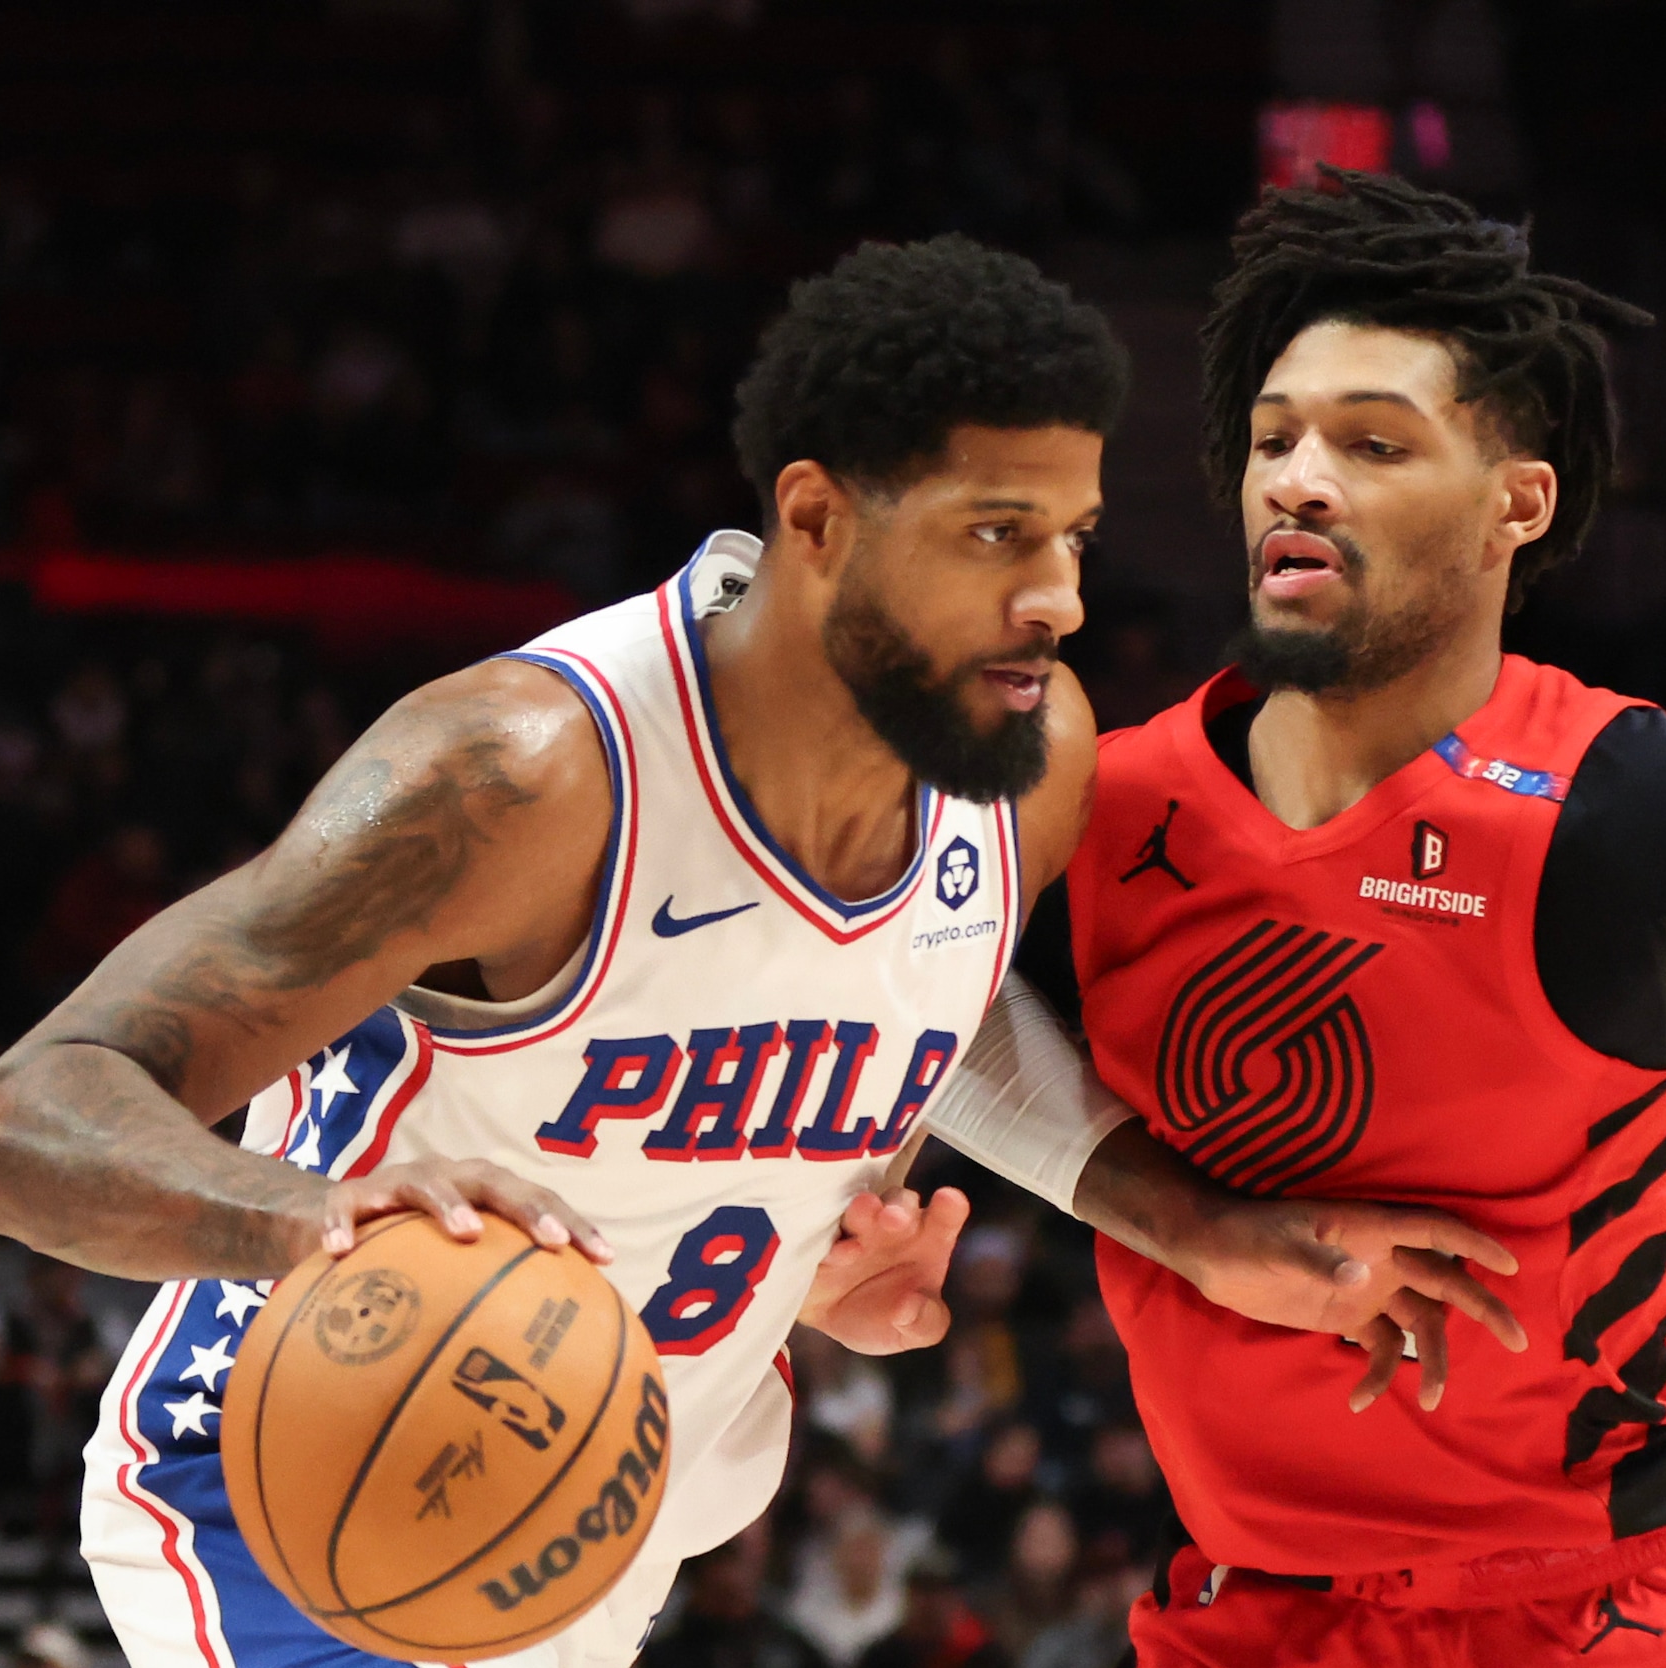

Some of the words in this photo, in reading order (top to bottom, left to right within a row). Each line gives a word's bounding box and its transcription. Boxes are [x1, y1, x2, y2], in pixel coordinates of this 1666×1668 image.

[1482, 760, 1523, 789] 32
[1359, 876, 1487, 918] BRIGHTSIDE
[912, 919, 997, 950] crypto.com
[534, 1018, 959, 1163] PHILA
[637, 1204, 781, 1357] 8
